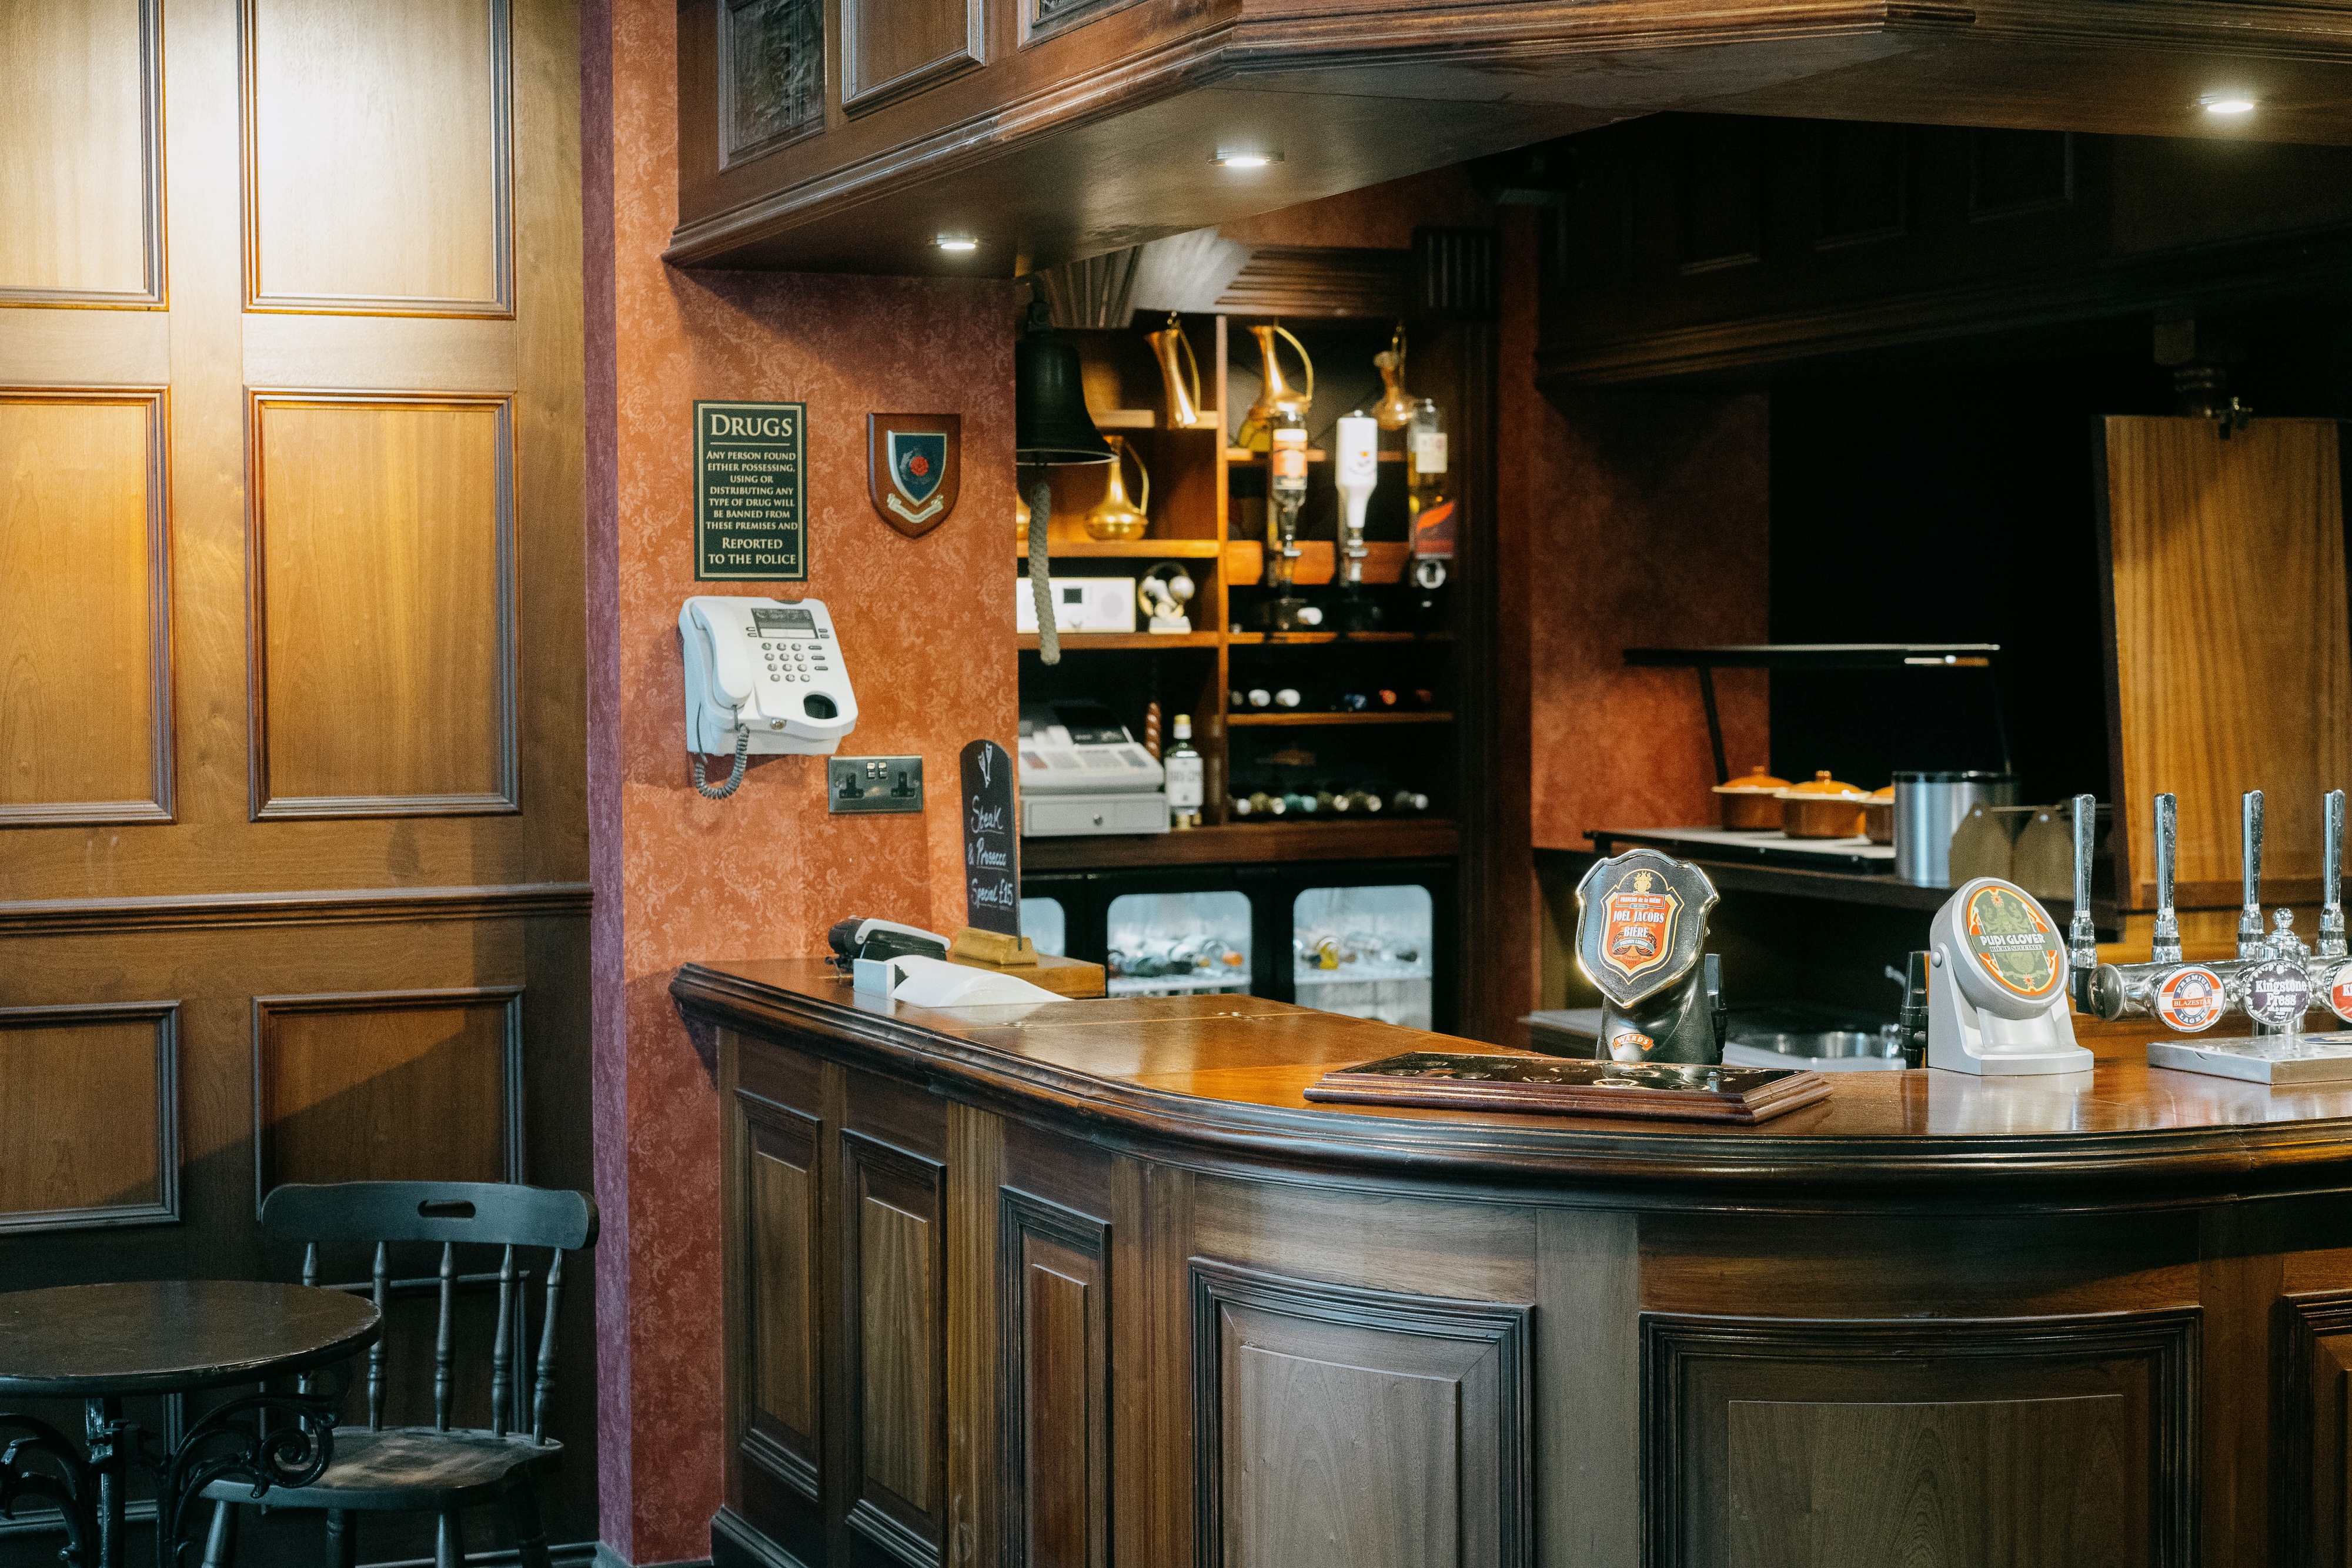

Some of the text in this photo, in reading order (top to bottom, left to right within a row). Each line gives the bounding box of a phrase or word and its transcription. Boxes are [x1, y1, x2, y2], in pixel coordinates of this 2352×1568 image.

[710, 414, 793, 437] DRUGS
[706, 450, 796, 460] ANY PERSON FOUND
[707, 463, 740, 471] EITHER
[730, 475, 774, 483] USING OR
[710, 486, 774, 494] DISTRIBUTING
[709, 498, 729, 506] TYPE
[746, 499, 771, 507] DRUG
[773, 499, 795, 507] WILL
[713, 510, 790, 519] BE BANNED FROM
[706, 521, 733, 529] THESE
[736, 521, 776, 530] PREMISES
[722, 537, 783, 549] REPORTED
[708, 554, 797, 564] TO THE POLICE
[998, 878, 1013, 906] £15
[1633, 911, 1665, 924] JACOBS
[1979, 934, 2046, 945] PUDI GLOVER
[2176, 975, 2210, 994] PREMIUM
[2256, 979, 2307, 995] Kingstone
[2174, 998, 2211, 1007] BLAZESTAR
[2266, 992, 2296, 1006] Press
[2179, 1011, 2206, 1024] LAGER
[1617, 1035, 1649, 1045] WARD'S
